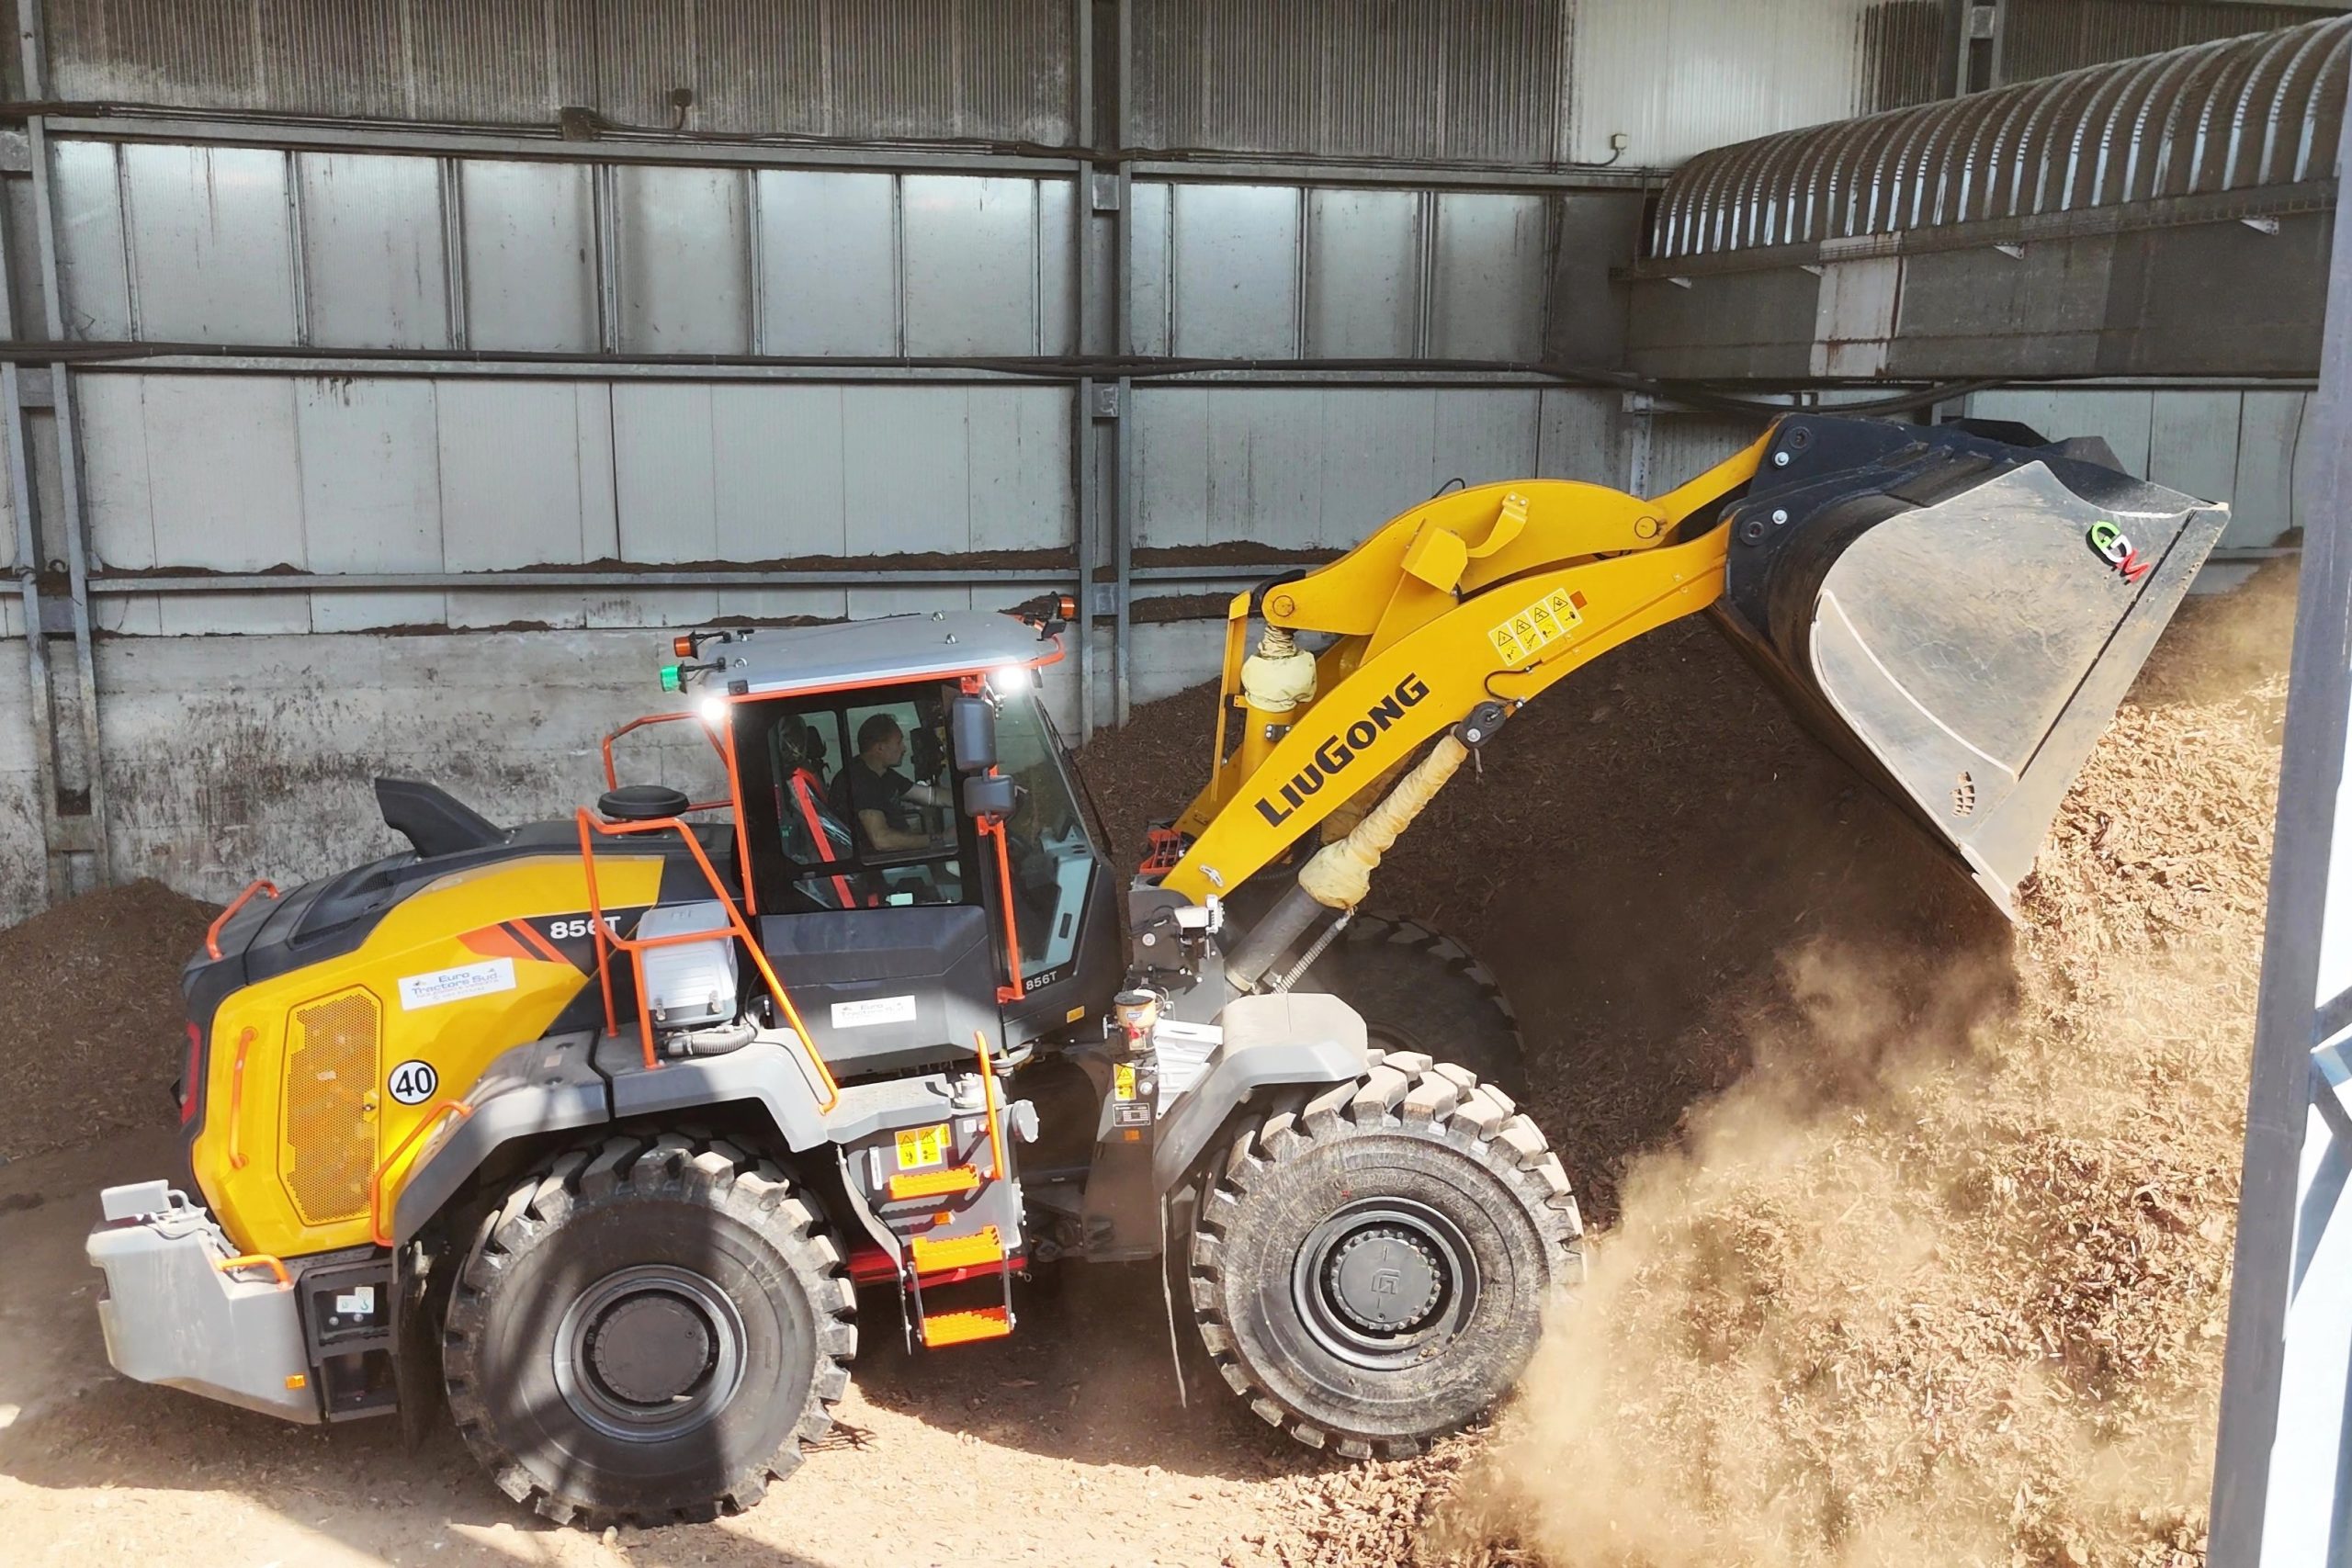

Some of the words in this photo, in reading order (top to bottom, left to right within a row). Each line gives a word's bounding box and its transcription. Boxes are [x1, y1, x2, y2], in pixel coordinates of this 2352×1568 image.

[412, 978, 469, 995] Tractors
[472, 972, 498, 984] Sud
[438, 973, 470, 983] Euro
[1025, 970, 1057, 990] 856T
[395, 1066, 432, 1097] 40
